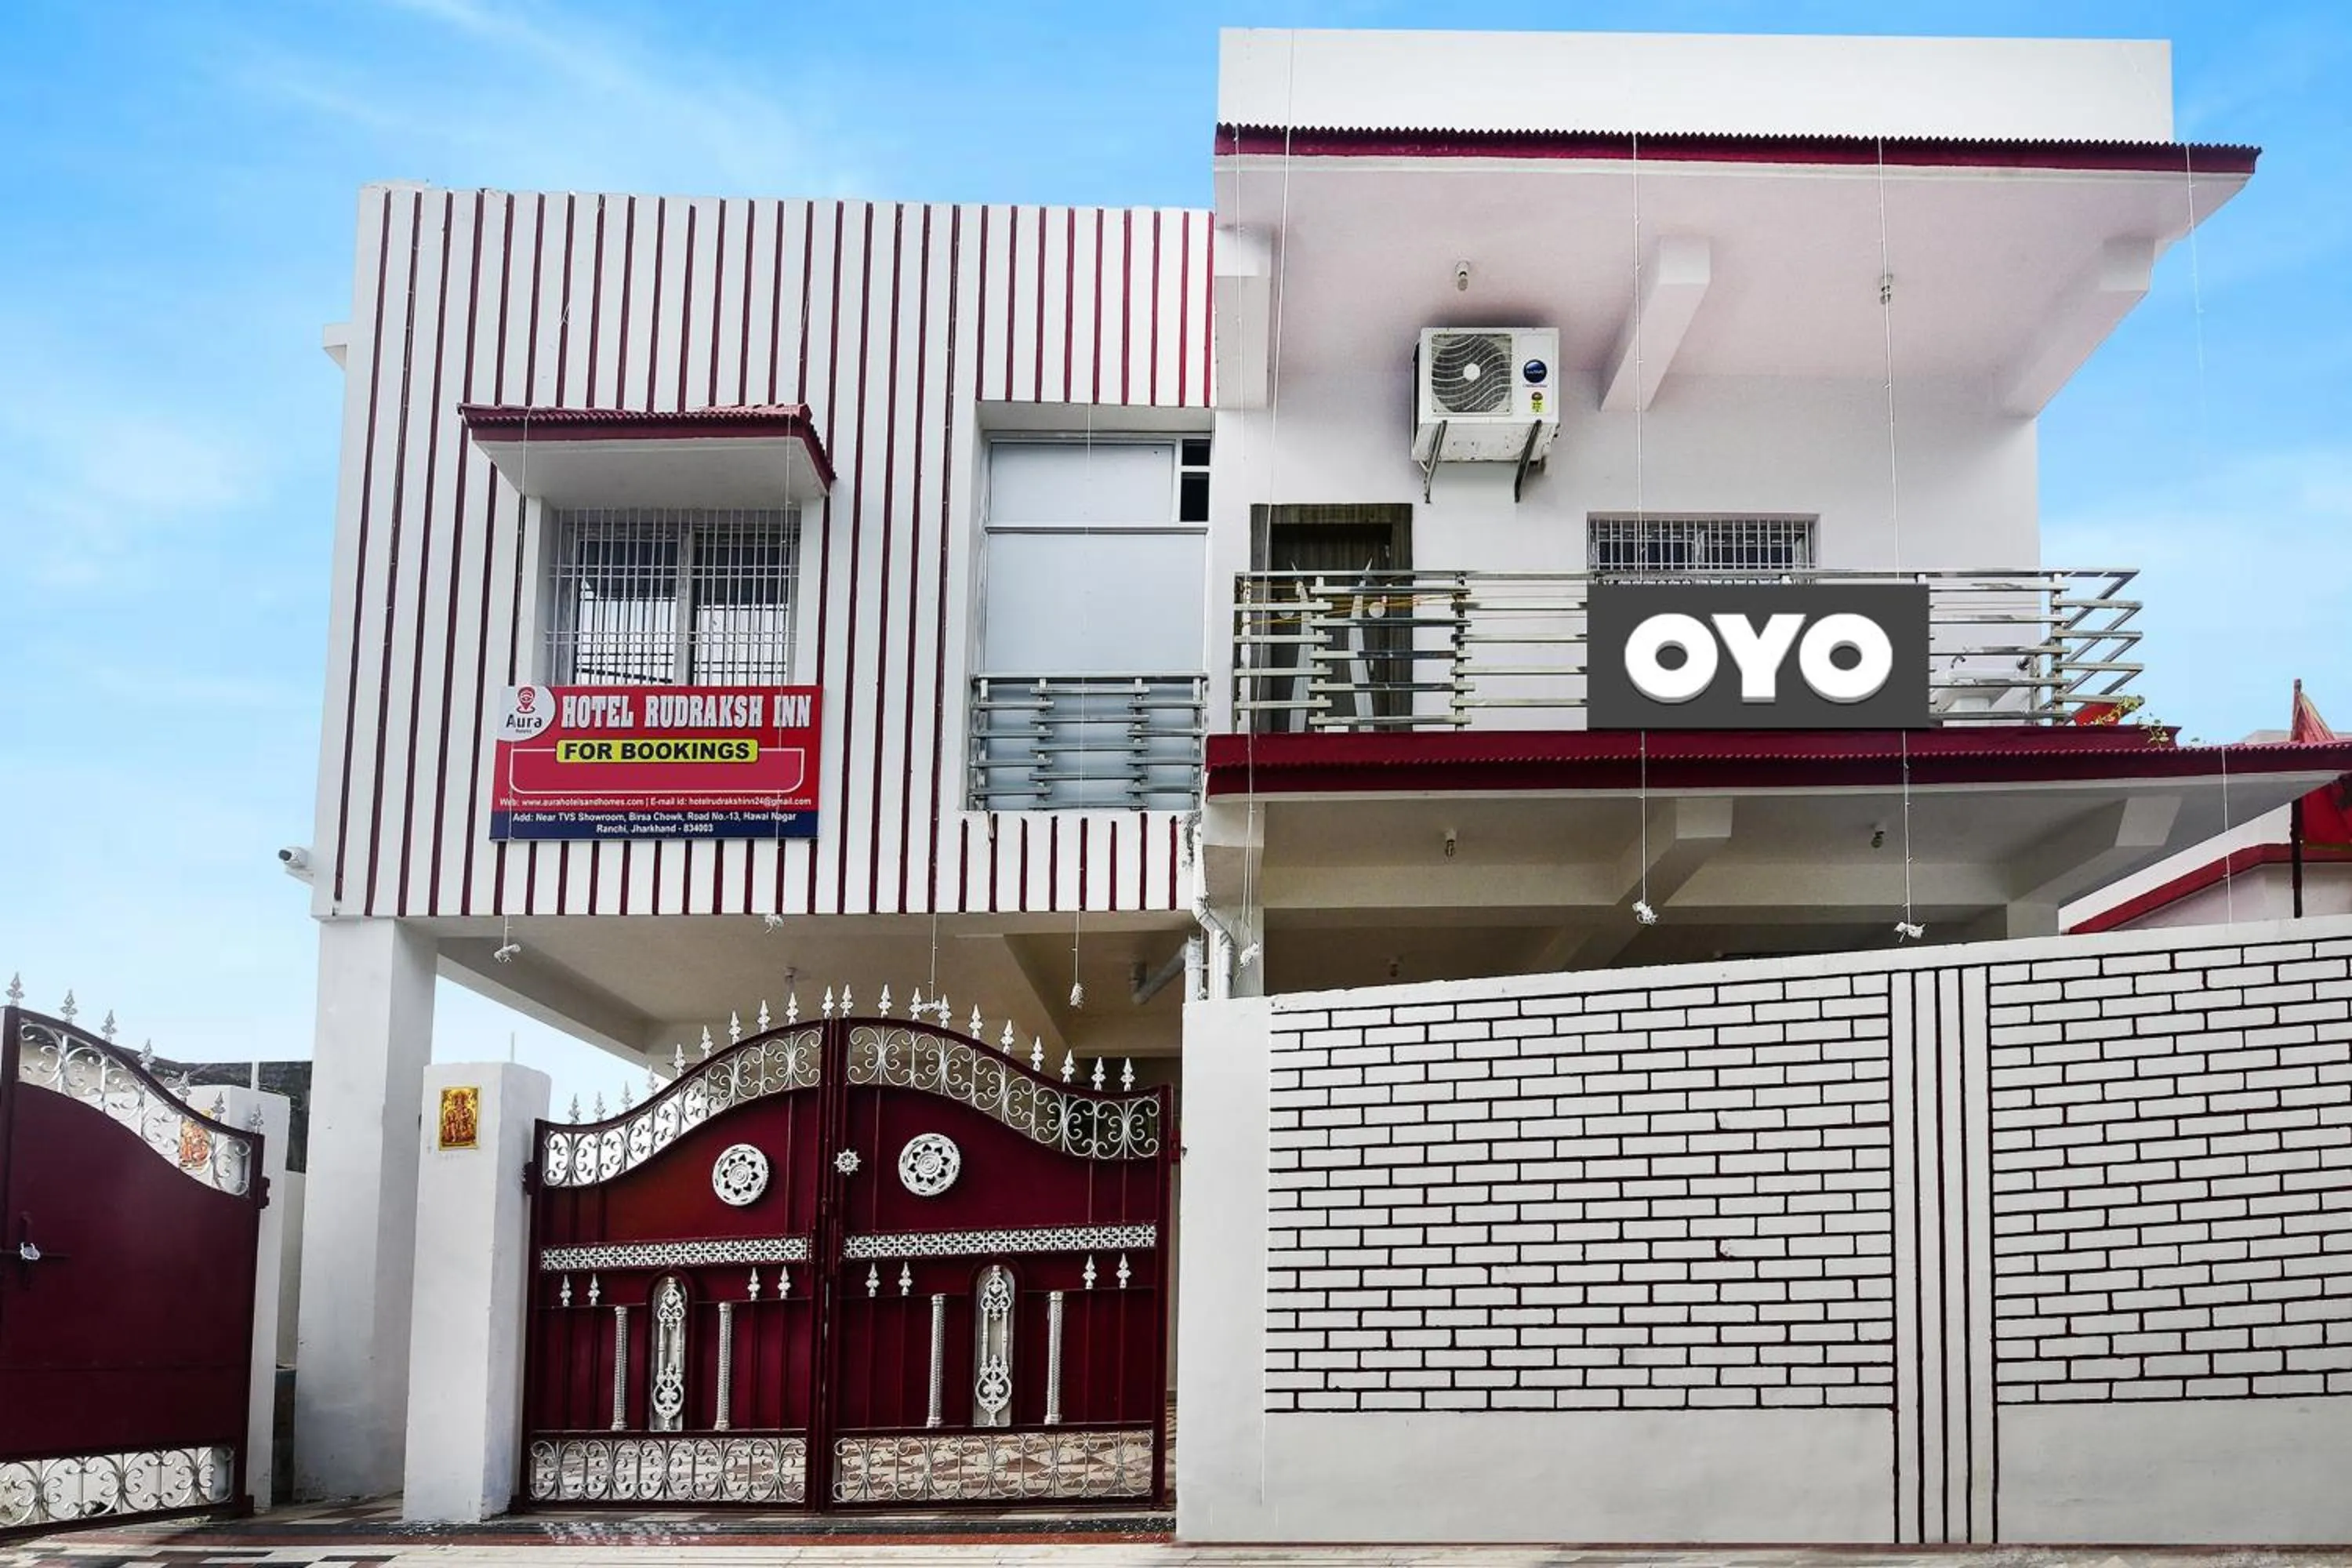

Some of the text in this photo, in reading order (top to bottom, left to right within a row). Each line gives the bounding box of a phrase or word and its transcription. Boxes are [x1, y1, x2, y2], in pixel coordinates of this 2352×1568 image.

[1624, 612, 1893, 704] OYO
[561, 695, 812, 728] HOTEL RUDRAKSH INN
[506, 714, 543, 728] Aura
[564, 742, 750, 760] FOR BOOKINGS
[512, 813, 534, 822] Add:
[535, 813, 556, 822] Near
[558, 812, 576, 821] TVS
[578, 812, 626, 822] Showroom,
[628, 812, 651, 821] Birsa
[653, 812, 684, 822] Chowk,
[688, 812, 710, 821] Road
[771, 812, 797, 822] Nagar
[630, 824, 677, 833] Jharkhand
